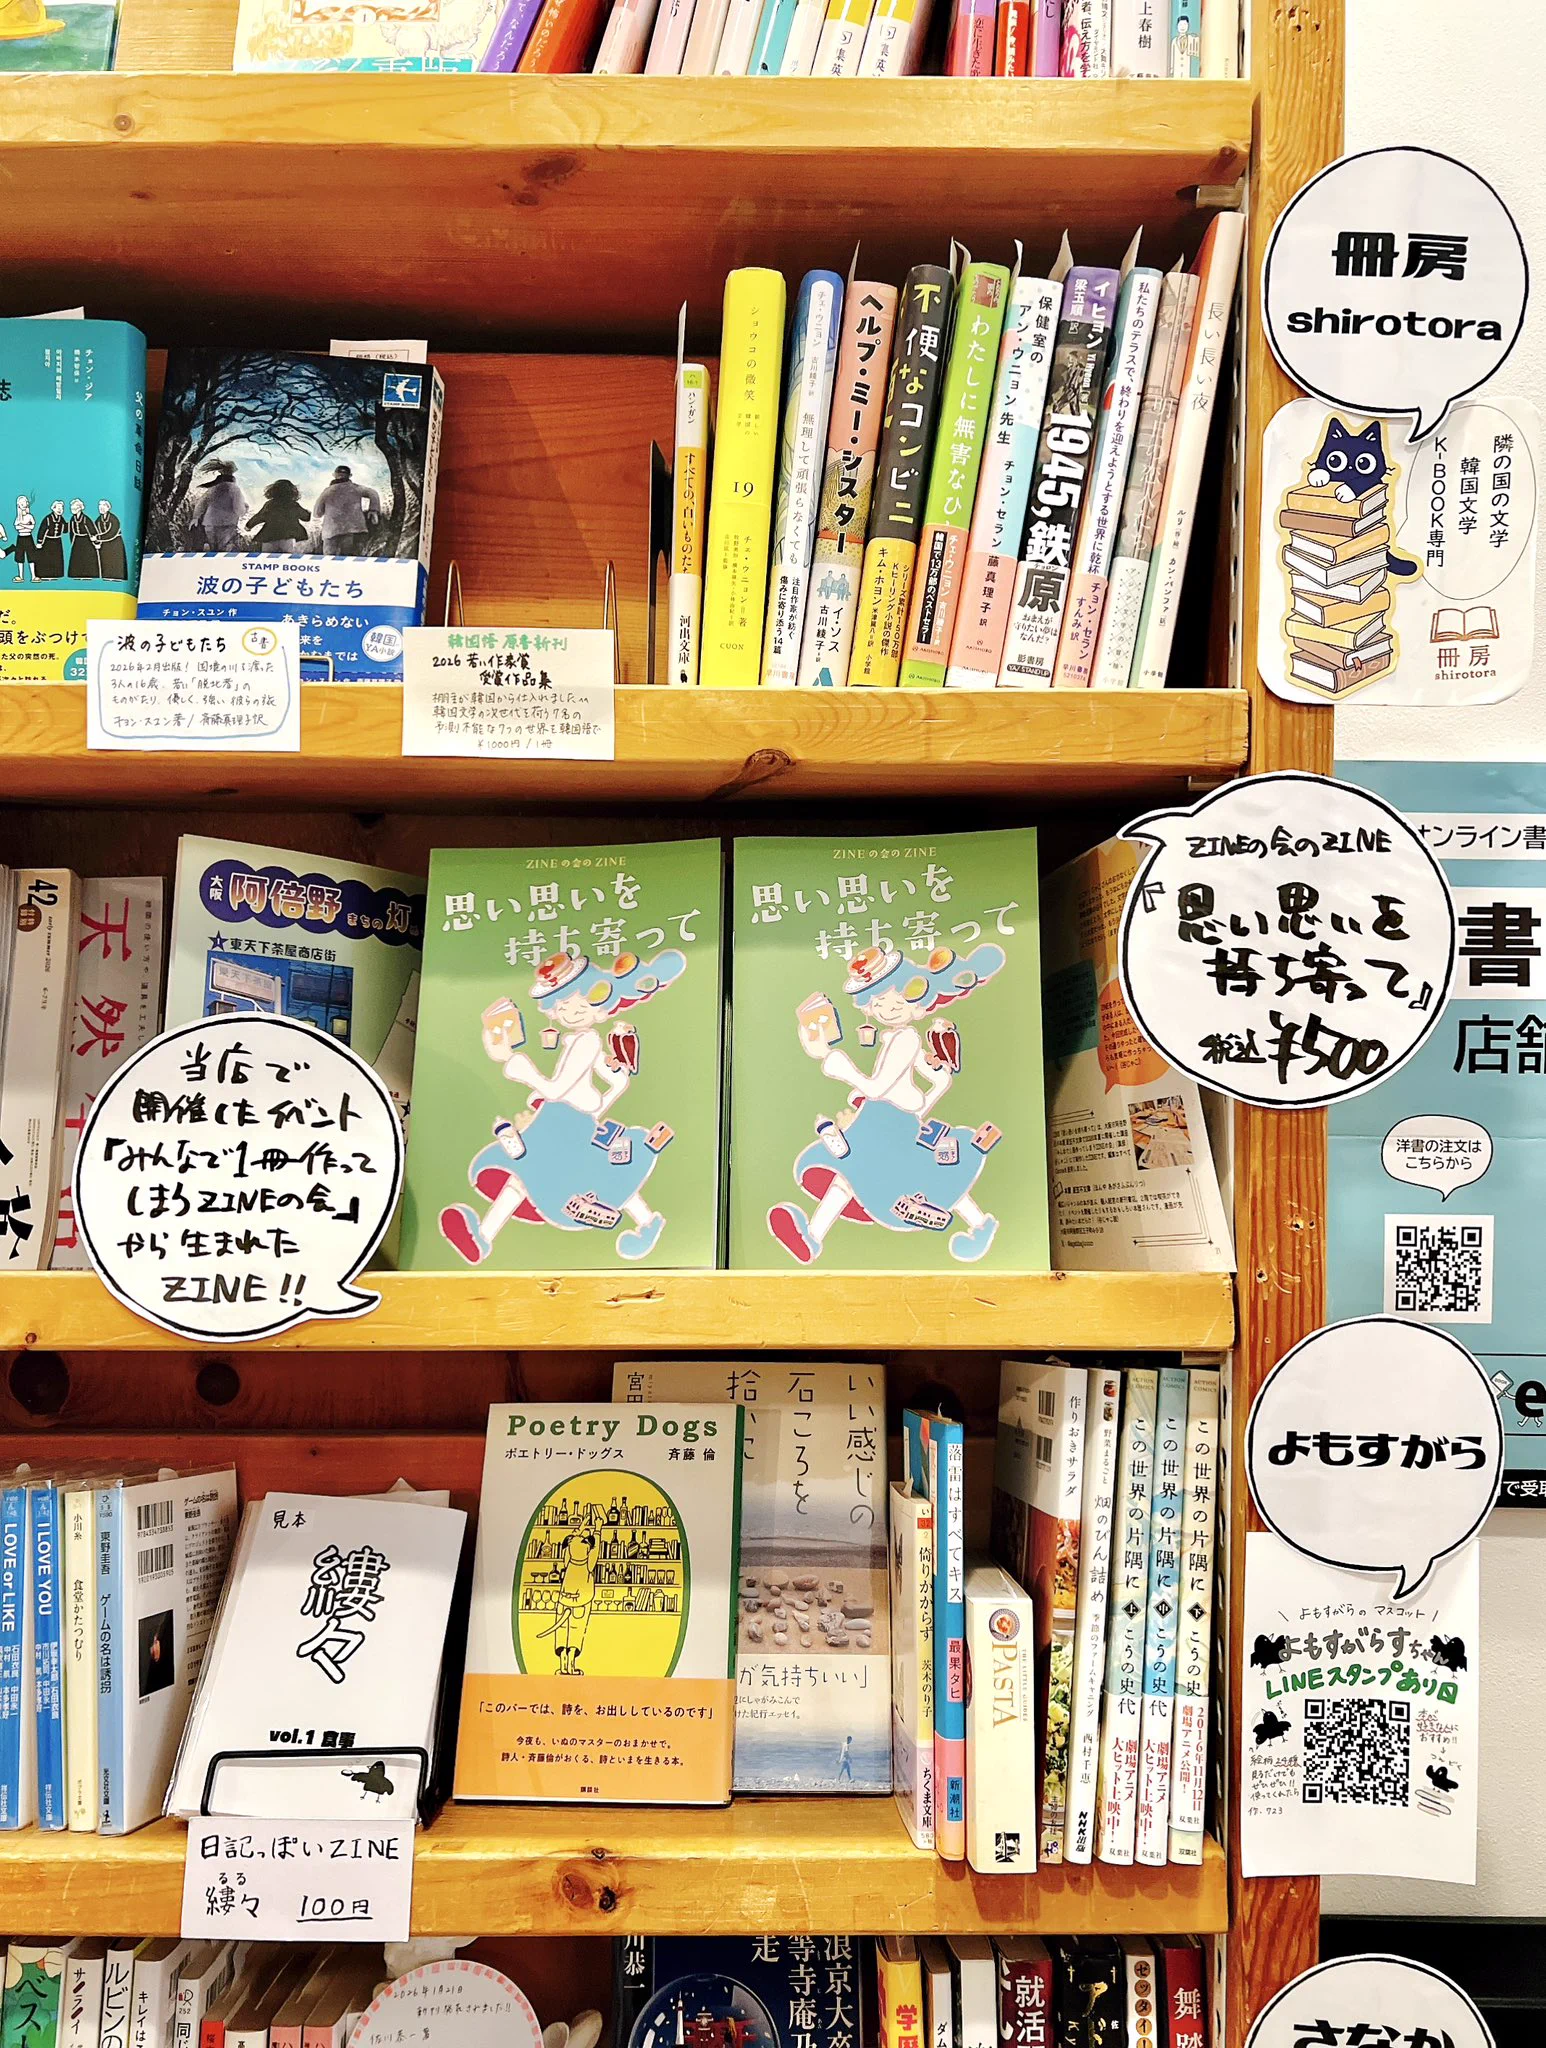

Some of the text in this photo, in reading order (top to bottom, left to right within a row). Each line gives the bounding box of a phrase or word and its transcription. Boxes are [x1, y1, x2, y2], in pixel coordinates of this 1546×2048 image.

[1332, 231, 1468, 281] 冊房
[1029, 296, 1053, 364] 保健室の
[1287, 307, 1502, 341] shirotora
[85, 349, 94, 401] チョン・ジア
[744, 306, 760, 401] ショウコの微笑
[997, 304, 1032, 446] アン・ウニョン先生
[1191, 302, 1225, 412] 長い長い夜
[687, 392, 697, 424] ハン・ガン
[833, 294, 885, 554] ヘルプ・ミー・シスター
[888, 283, 942, 524] 不便なコンビニ
[943, 314, 990, 527] わたしに無害なひ
[732, 481, 754, 498] 19
[789, 412, 816, 565] 無理して頑張らなくても
[991, 460, 1016, 548] チョン・セラン
[1425, 436, 1448, 568] K-BOOK専門
[1457, 456, 1481, 535] 韓国文学
[1488, 433, 1514, 549] 隣の国の文学
[681, 452, 696, 574] すべての、白いものた
[196, 575, 364, 599] 波の子どもたち
[241, 563, 321, 573] STAMP BOOKS
[871, 547, 889, 607] キム・ホヨン
[920, 531, 947, 643] 韓国で13万部のベストセラー
[162, 608, 225, 618] チョン・スユン
[281, 614, 370, 629] あきらめない
[788, 576, 801, 641] 注目作家が紡ぐ
[828, 607, 844, 653] イ・ソス
[1079, 582, 1102, 660] チョン・セラン
[117, 633, 227, 653] 波の子どもたち
[250, 632, 270, 650] 古書
[370, 632, 397, 646] 韓国
[678, 615, 691, 665] 河出文庫
[719, 642, 745, 651] CUON
[1016, 653, 1045, 667] 影書房
[1436, 644, 1491, 669] 冊房
[863, 654, 873, 675] 小学館
[1434, 668, 1497, 681] shirotora
[1186, 826, 1392, 859] ZINEの会のZINE
[28, 879, 59, 906] 42
[208, 875, 224, 902] 大阪
[229, 872, 342, 924] 阿倍野
[442, 872, 642, 932] 思い思いを
[751, 863, 954, 924] 思い思いを
[814, 901, 1019, 960] 持ち寄って
[1141, 881, 1411, 945] 『思い思いを
[230, 937, 337, 962] 東天下茶屋商店街
[503, 908, 701, 967] 持ち寄って
[1458, 902, 1542, 987] 書
[1202, 942, 1433, 1011] 持ち寄って』
[180, 1042, 311, 1084] 当店で
[1396, 1138, 1482, 1153] 洋書の注文は
[1405, 1156, 1473, 1170] こちらから
[117, 1228, 300, 1260] から生まれた
[507, 1414, 719, 1443] Poetry Dogs
[787, 1372, 816, 1516] 石ころを
[1064, 1395, 1082, 1497] 作りおきサラダ
[1268, 1430, 1487, 1470] よもすがら
[504, 1447, 625, 1460] ポエトリー・ドッグス
[846, 1374, 877, 1530] いい感じの
[1102, 1428, 1113, 1485] 野菜まるごと
[73, 1513, 83, 1541] 小川糸
[273, 1510, 306, 1530] 見本
[947, 1444, 963, 1601] 落雷はすべてキス
[1188, 1420, 1212, 1592] この世界の片隅に
[3, 1523, 18, 1568] LOVE
[37, 1533, 51, 1576] LOVE
[100, 1531, 111, 1575] 東野圭吾
[1089, 1495, 1112, 1604] 畑のびん詰め
[1117, 1417, 1150, 1716] この世界の片隅に こうの史代
[1149, 1416, 1180, 1717] この世界の片隅に こうの史代
[3, 1571, 14, 1591] or
[38, 1581, 52, 1617] YOU
[2, 1592, 16, 1632] LIKE
[73, 1579, 84, 1662] 食堂かたつむり
[100, 1593, 112, 1694] ゲームの名は誘拐
[1278, 1626, 1450, 1666] よもすがらすちゃん
[739, 1663, 869, 1689] が気持ちいい」
[921, 1659, 933, 1718] 茨木のり子
[948, 1640, 962, 1700] 最果タヒ
[991, 1641, 1019, 1729] PASTA
[478, 1701, 716, 1720] 「このバーでは、詩を、お出ししているのです」
[269, 1728, 315, 1745] vol.1
[515, 1735, 673, 1750] 今夜も、いぬのマスターのおまかせで。
[1123, 1740, 1138, 1802] 劇場アニメ
[1156, 1741, 1170, 1803] 劇場アニメ
[922, 1767, 933, 1828] ちくま文庫
[949, 1779, 961, 1819] 新潮社
[200, 1834, 399, 1860] 日記っぽいZINE
[1108, 1847, 1130, 1857] 双葉社
[1141, 1849, 1162, 1860] 双葉社
[218, 1872, 247, 1886] るる
[300, 1895, 369, 1917] 100円
